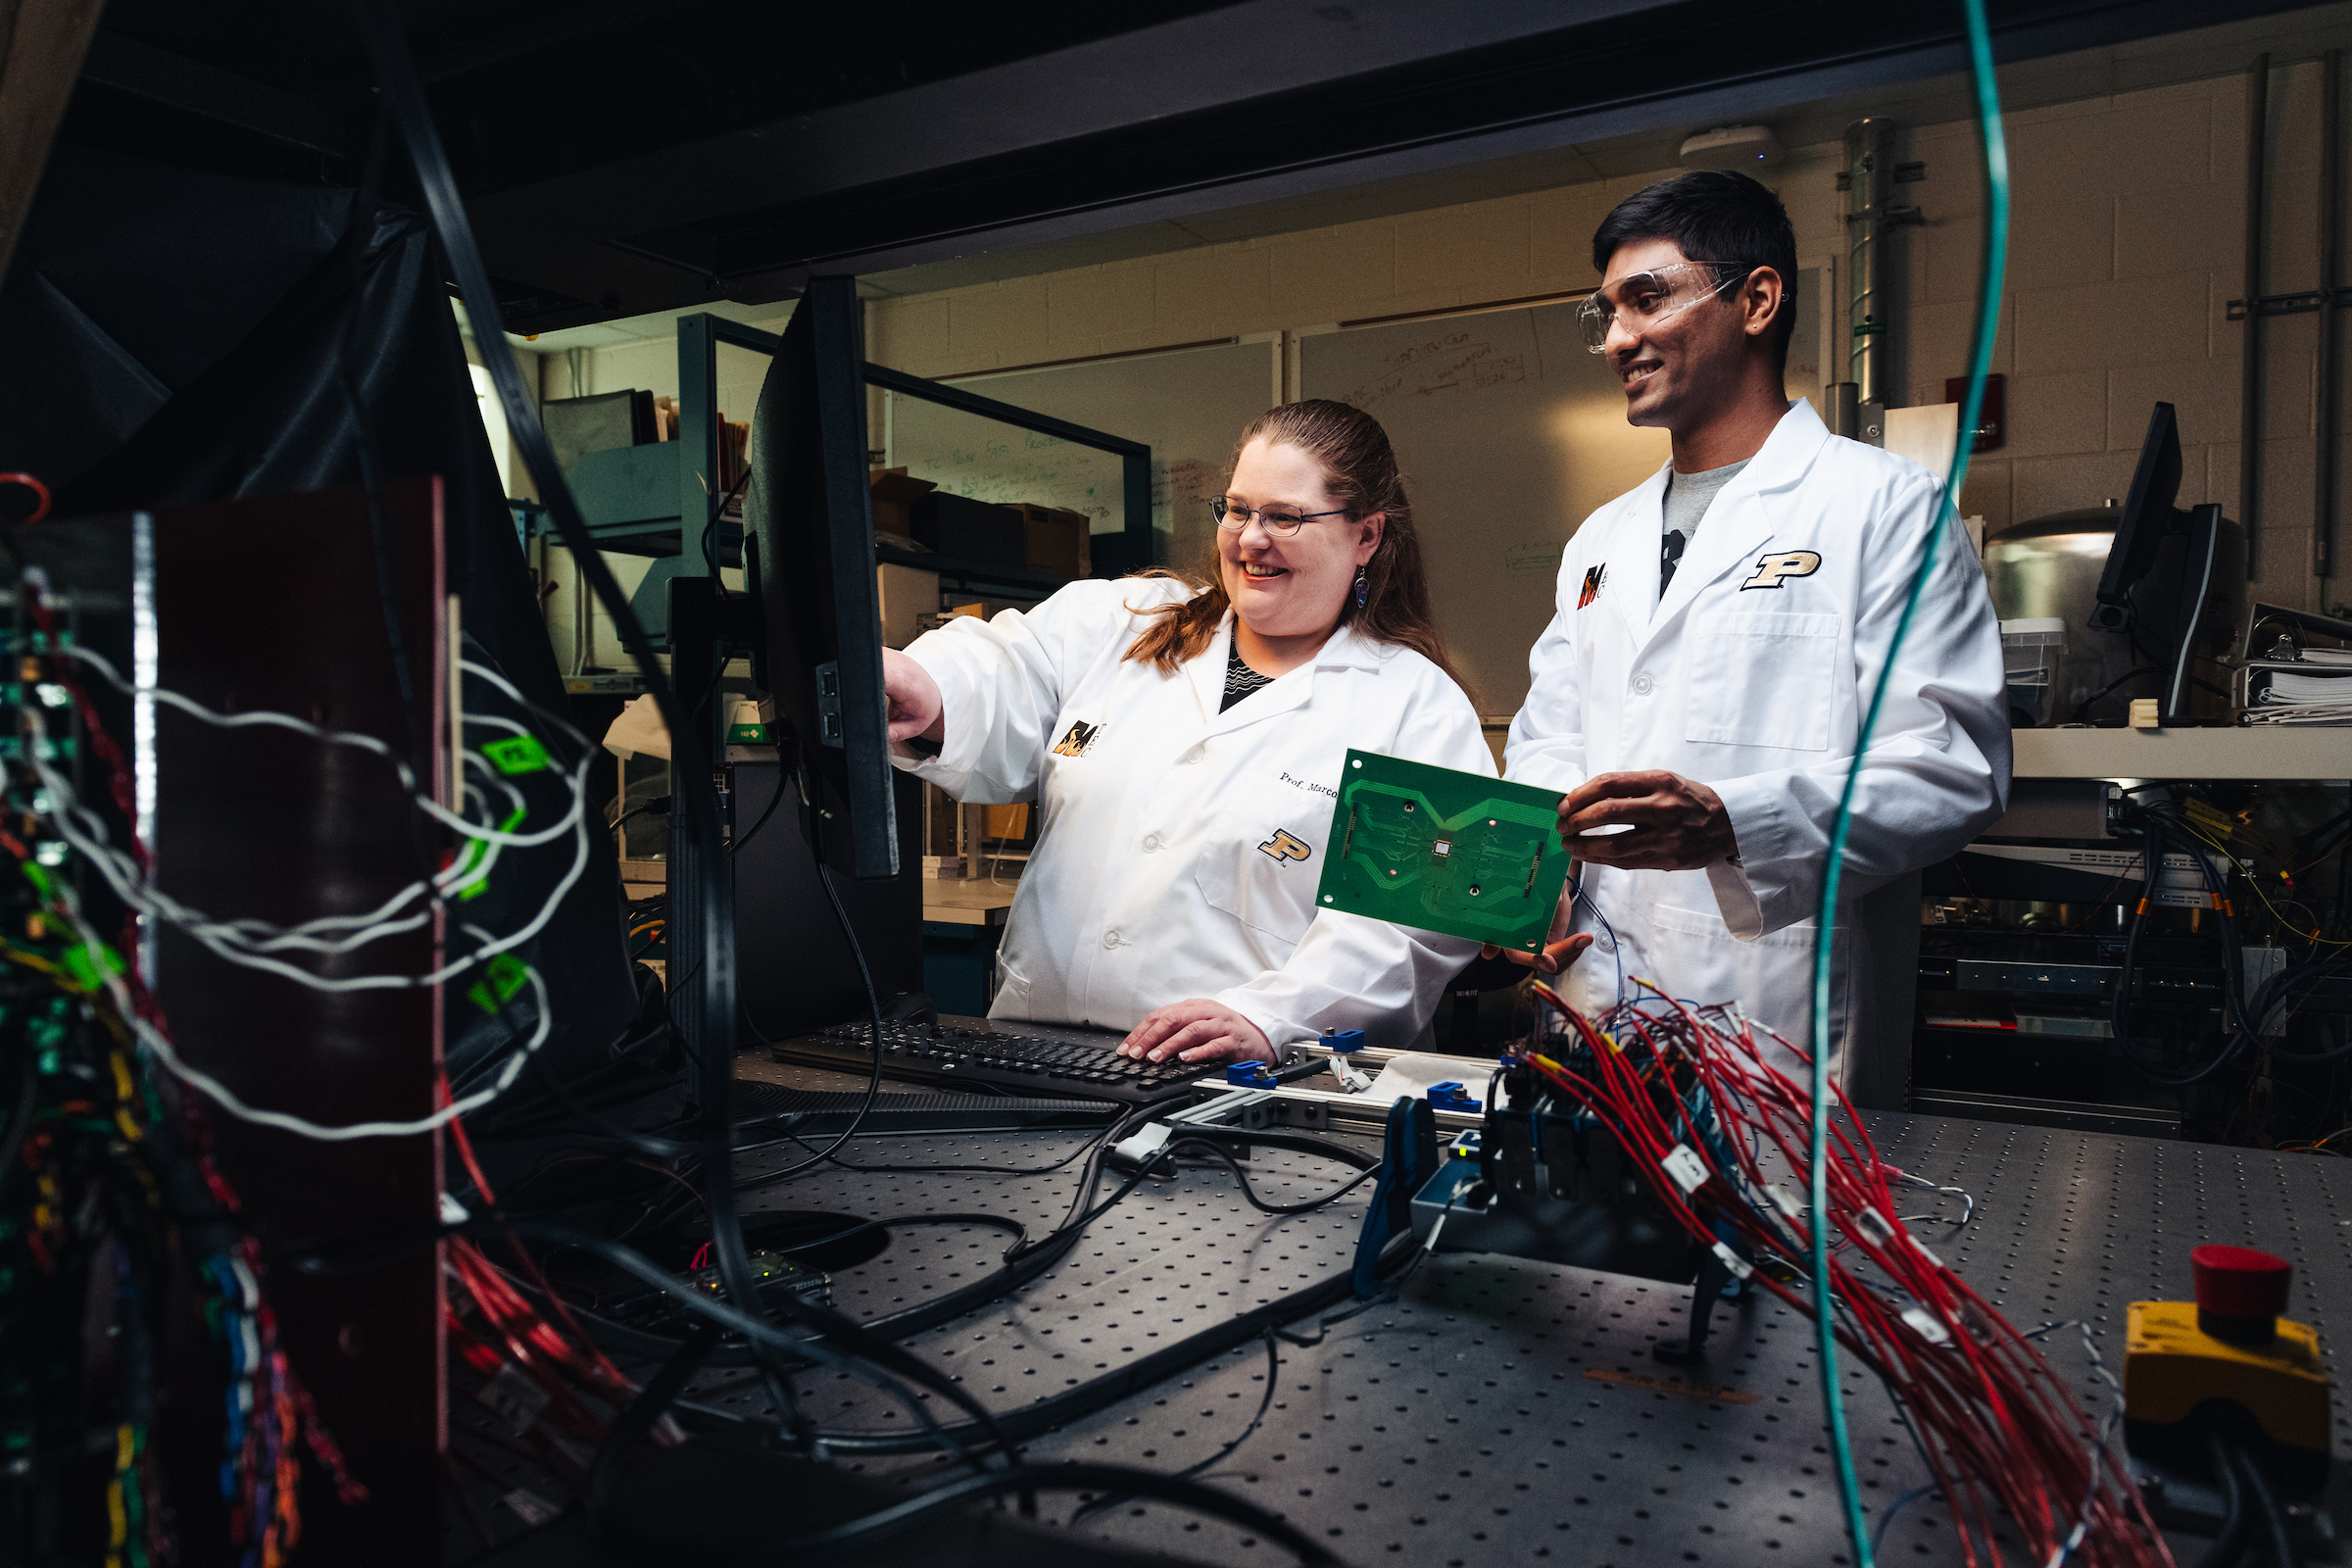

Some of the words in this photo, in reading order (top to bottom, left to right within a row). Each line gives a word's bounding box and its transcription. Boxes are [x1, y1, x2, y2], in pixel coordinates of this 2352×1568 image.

[1739, 550, 1823, 592] P
[1279, 771, 1304, 790] Prof.
[1307, 782, 1339, 800] Marco
[1257, 827, 1312, 862] P
